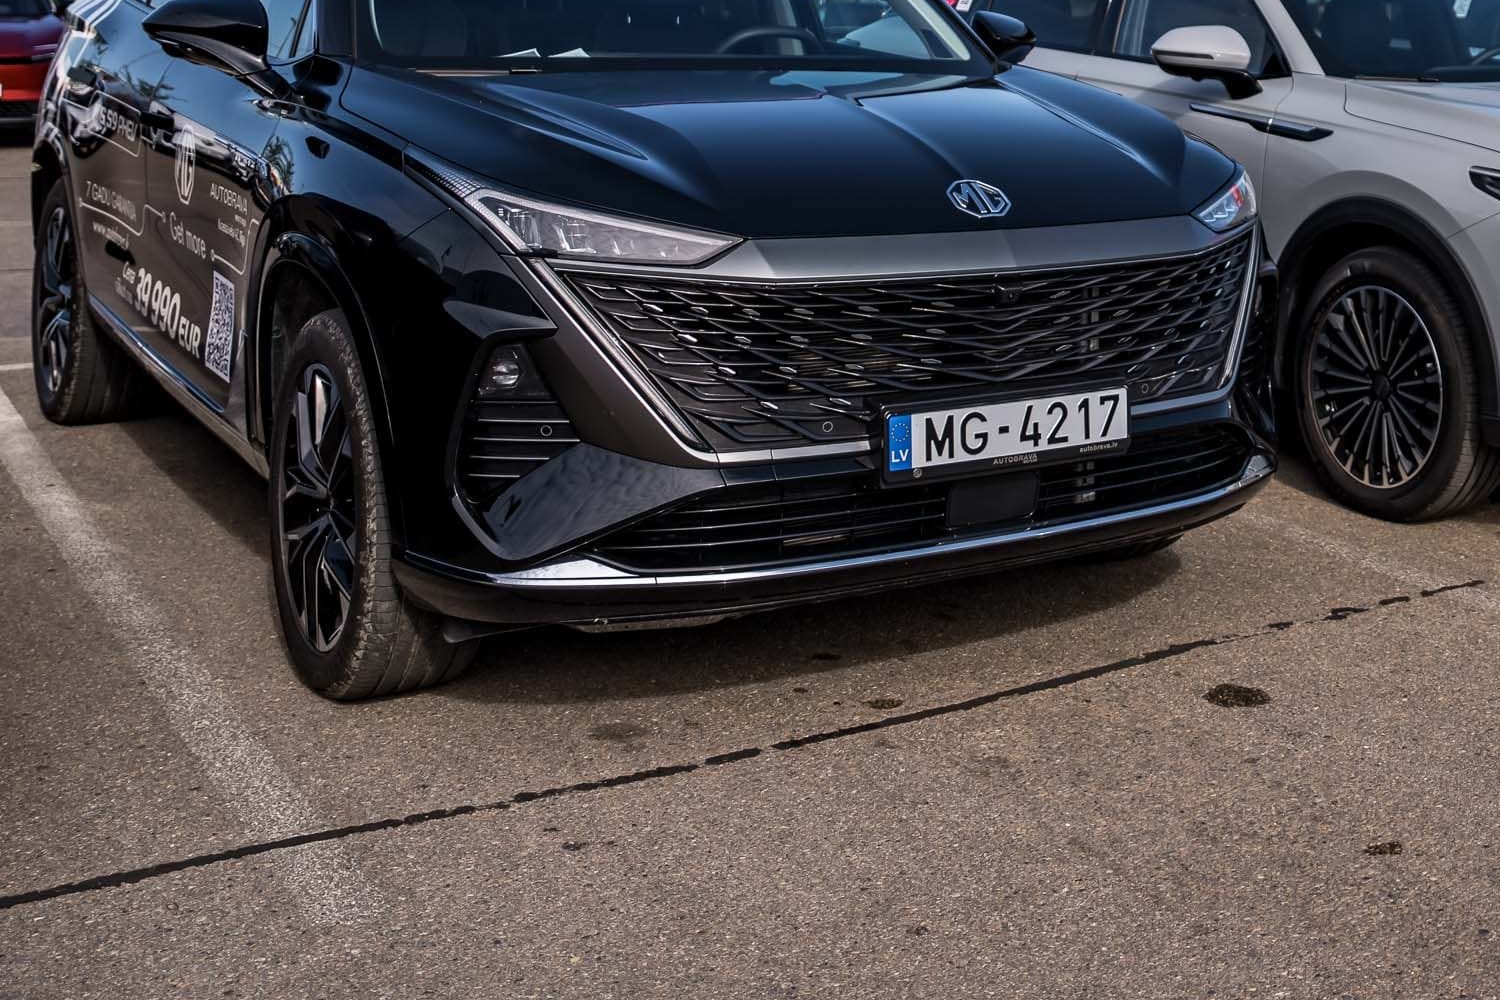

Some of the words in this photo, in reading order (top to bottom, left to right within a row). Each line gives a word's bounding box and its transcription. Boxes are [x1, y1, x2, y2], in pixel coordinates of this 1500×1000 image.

[169, 211, 184, 245] Get
[185, 230, 206, 259] more
[134, 268, 152, 317] 39
[151, 280, 181, 339] 990
[179, 316, 201, 359] EUR
[925, 393, 1120, 462] MG-4217
[891, 449, 910, 463] LV
[992, 453, 1038, 465] AUTOBRAVA
[1079, 442, 1118, 453] autobrava.lv
